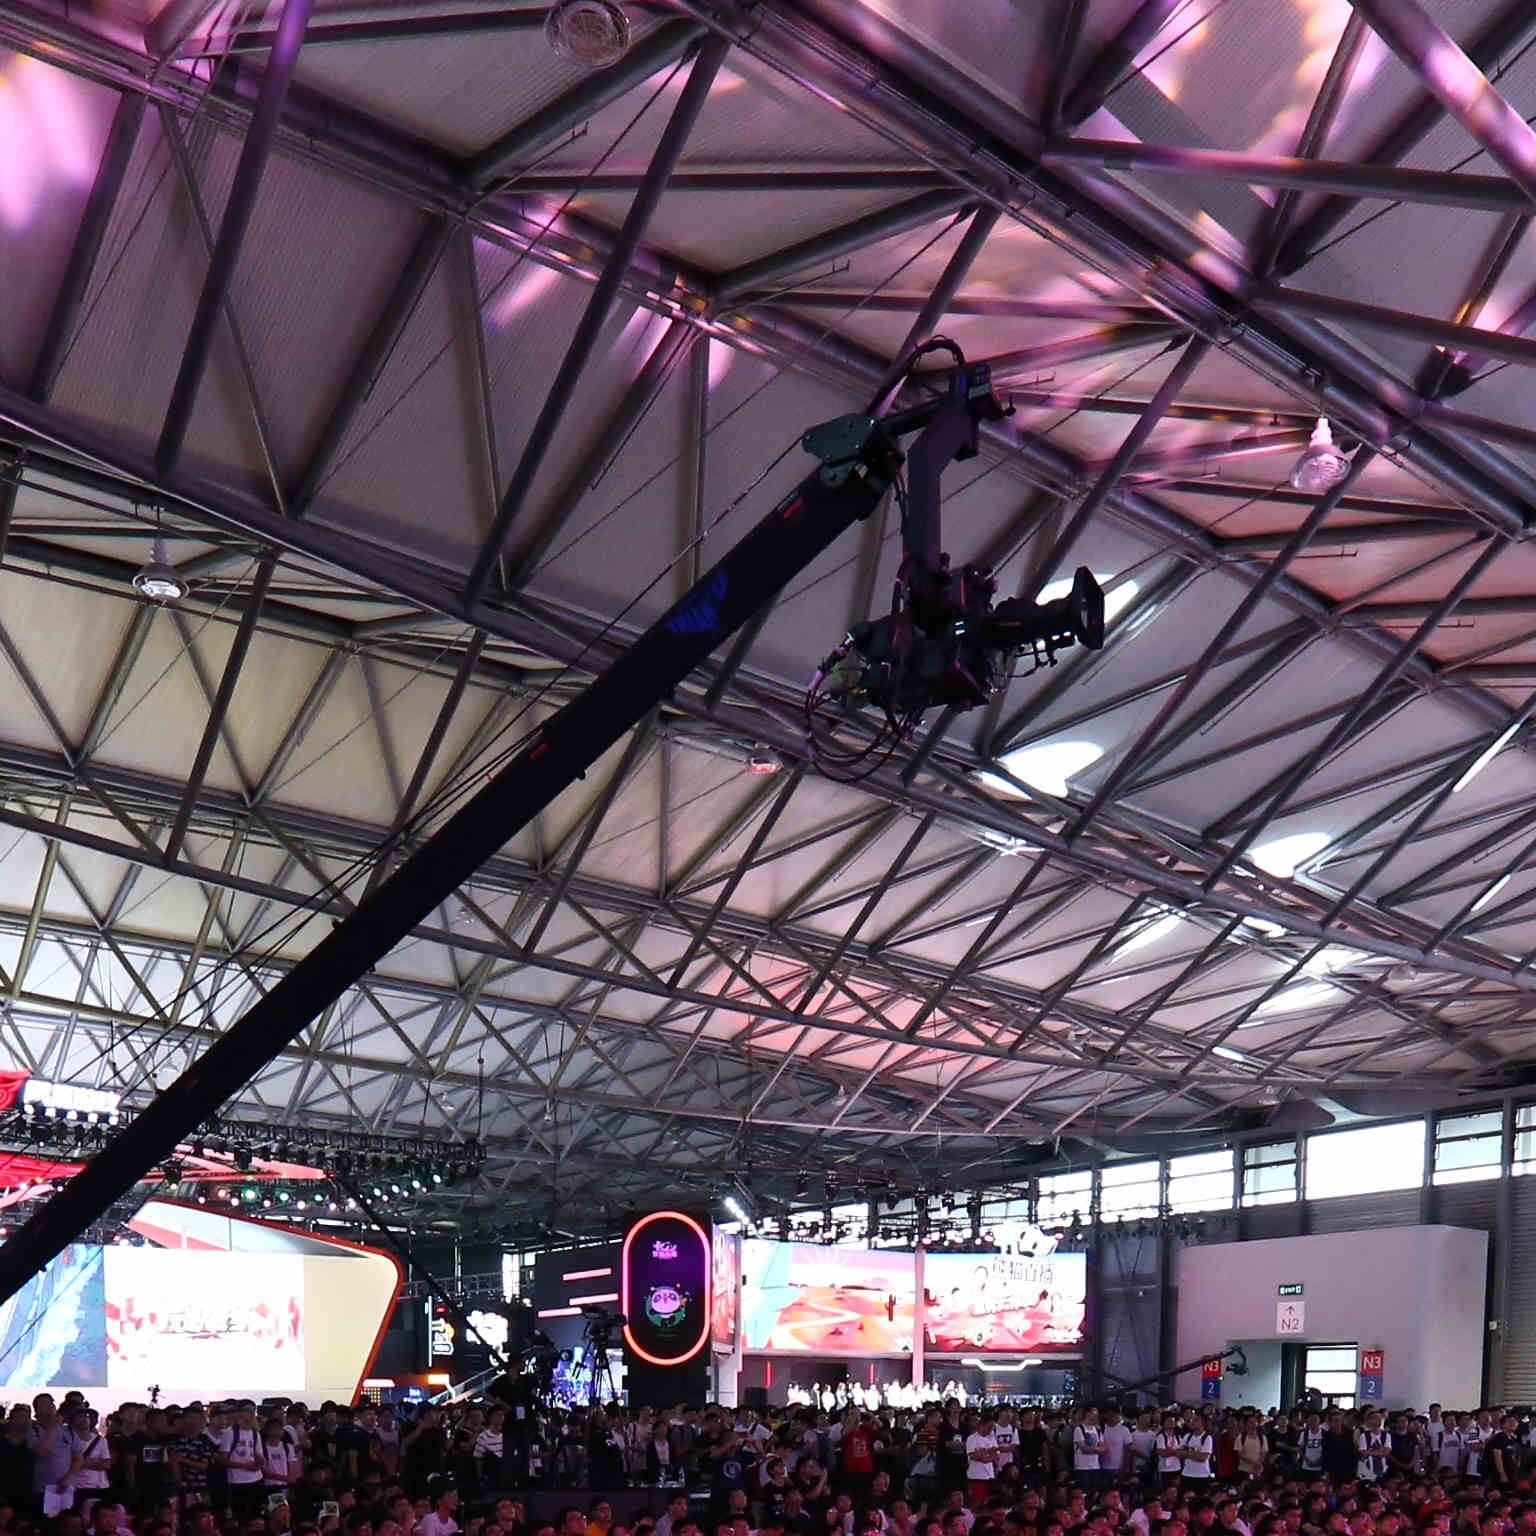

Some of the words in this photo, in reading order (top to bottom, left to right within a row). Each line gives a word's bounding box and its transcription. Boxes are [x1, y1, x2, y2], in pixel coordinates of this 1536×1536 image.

[1281, 1318, 1299, 1331] N2
[1204, 1360, 1220, 1373] N3
[1364, 1356, 1381, 1369] N3
[1207, 1382, 1215, 1393] 2
[1368, 1380, 1376, 1393] 2
